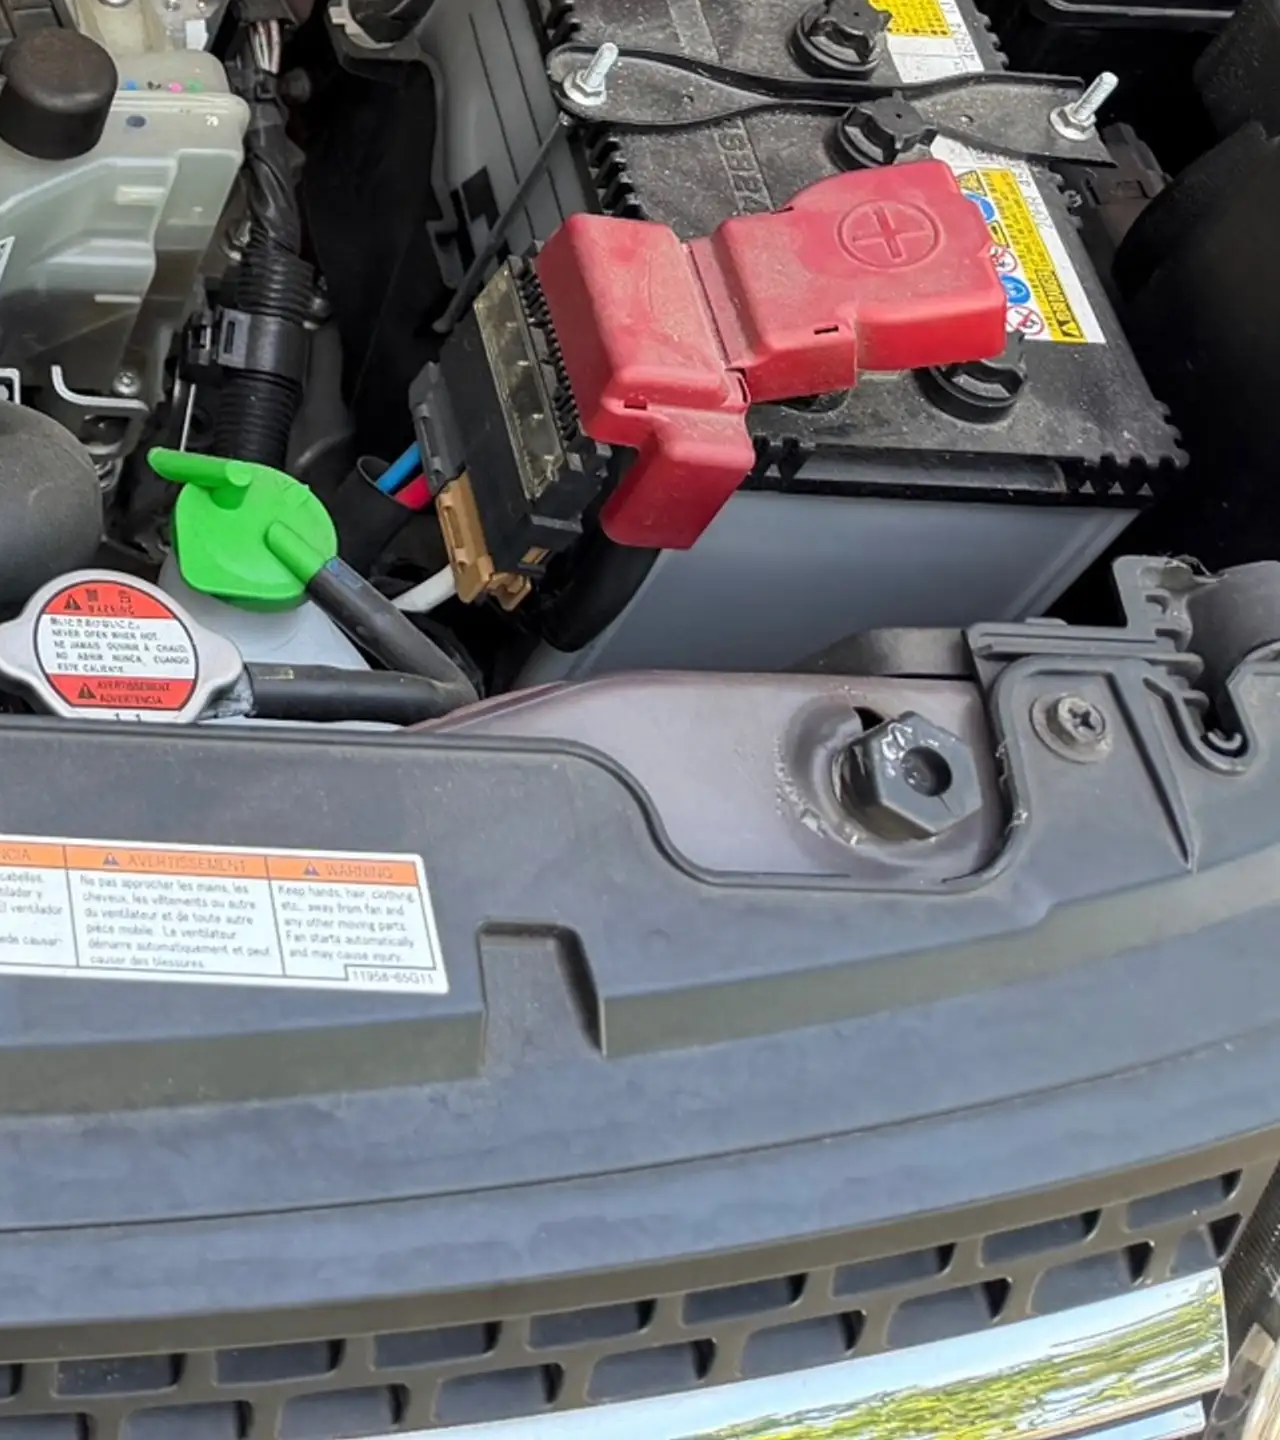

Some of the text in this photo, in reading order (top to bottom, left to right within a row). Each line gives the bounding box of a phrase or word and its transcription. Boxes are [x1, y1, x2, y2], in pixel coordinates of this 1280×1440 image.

[127, 854, 246, 872] AVERTISSEMENT
[325, 865, 393, 879] WARNING
[277, 884, 305, 897] Keep
